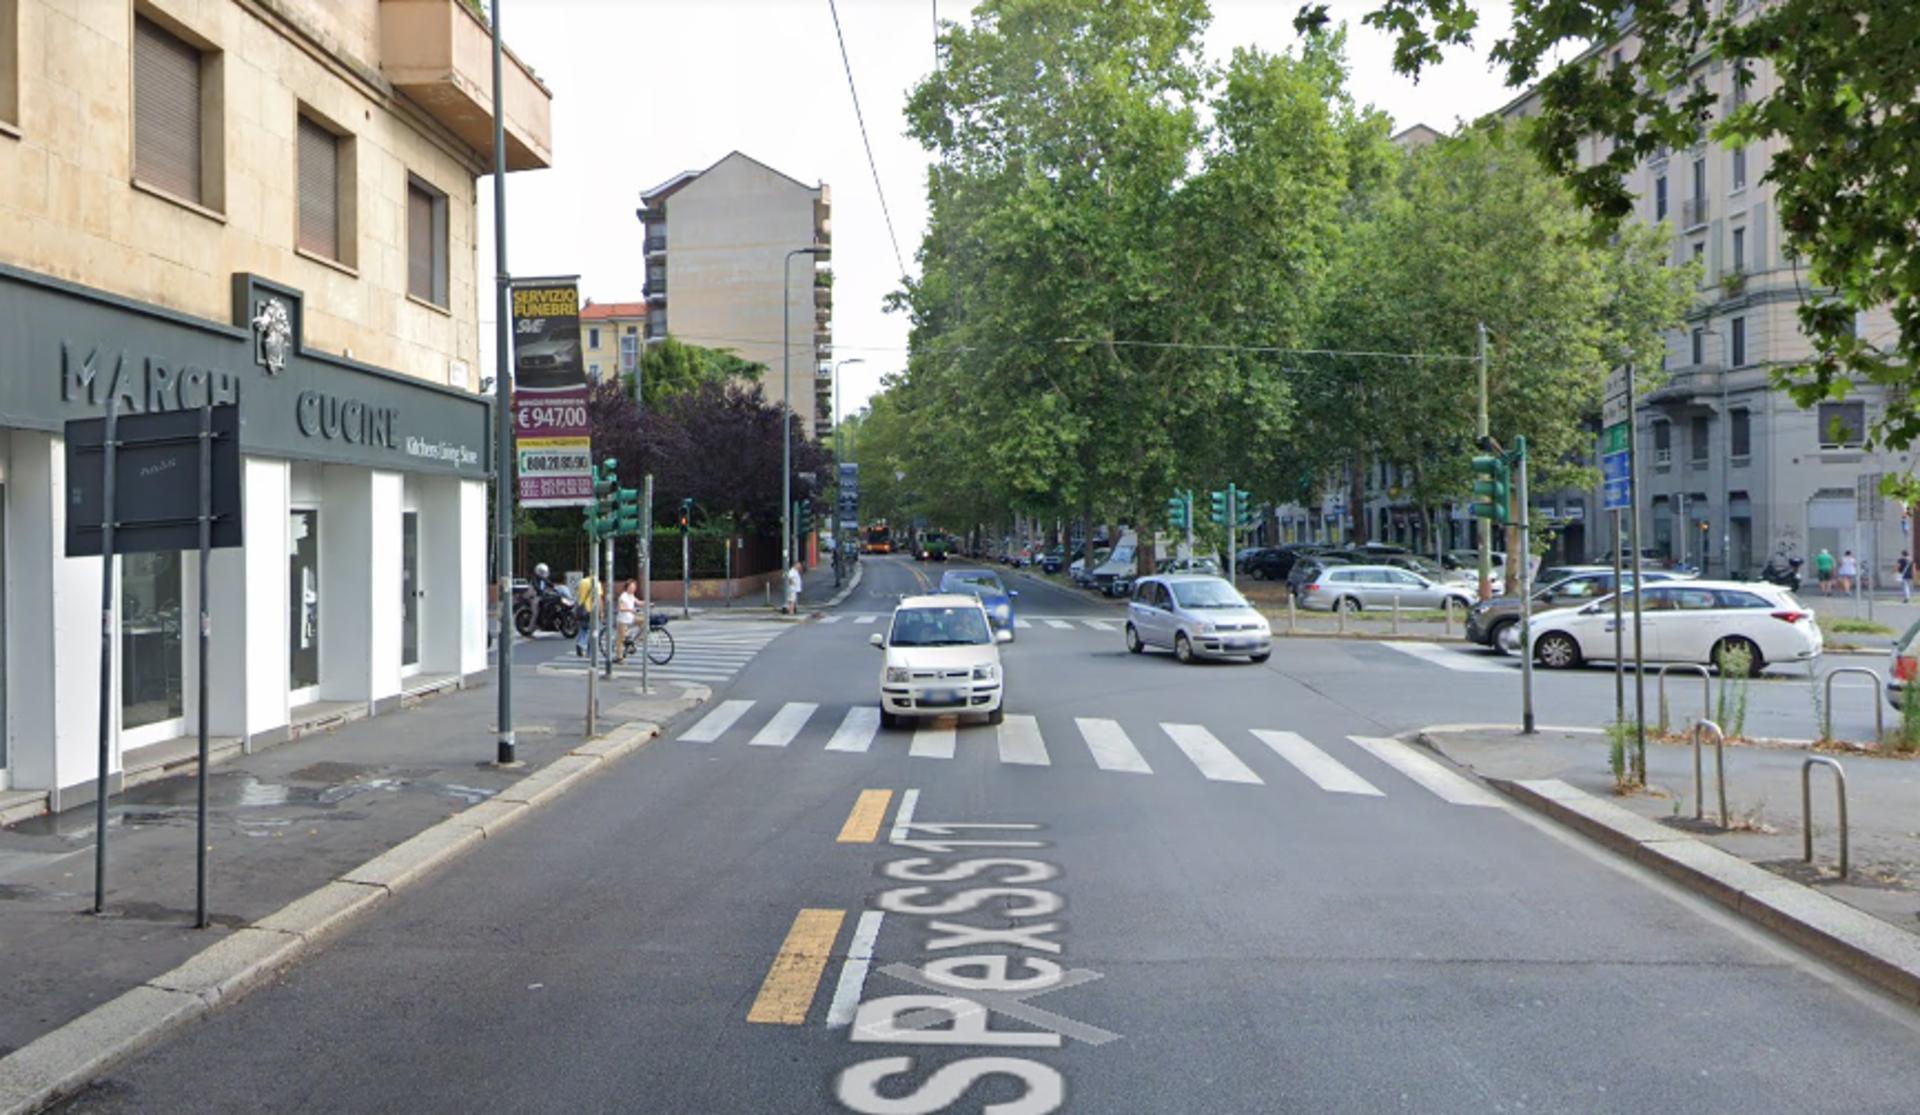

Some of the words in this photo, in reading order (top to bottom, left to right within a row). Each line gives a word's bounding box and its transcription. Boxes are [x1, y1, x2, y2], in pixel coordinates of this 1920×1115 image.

[513, 288, 576, 304] SERVIZIO
[514, 302, 578, 317] FUNEBRE
[296, 389, 400, 449] CUCINE
[532, 407, 587, 428] 947,00
